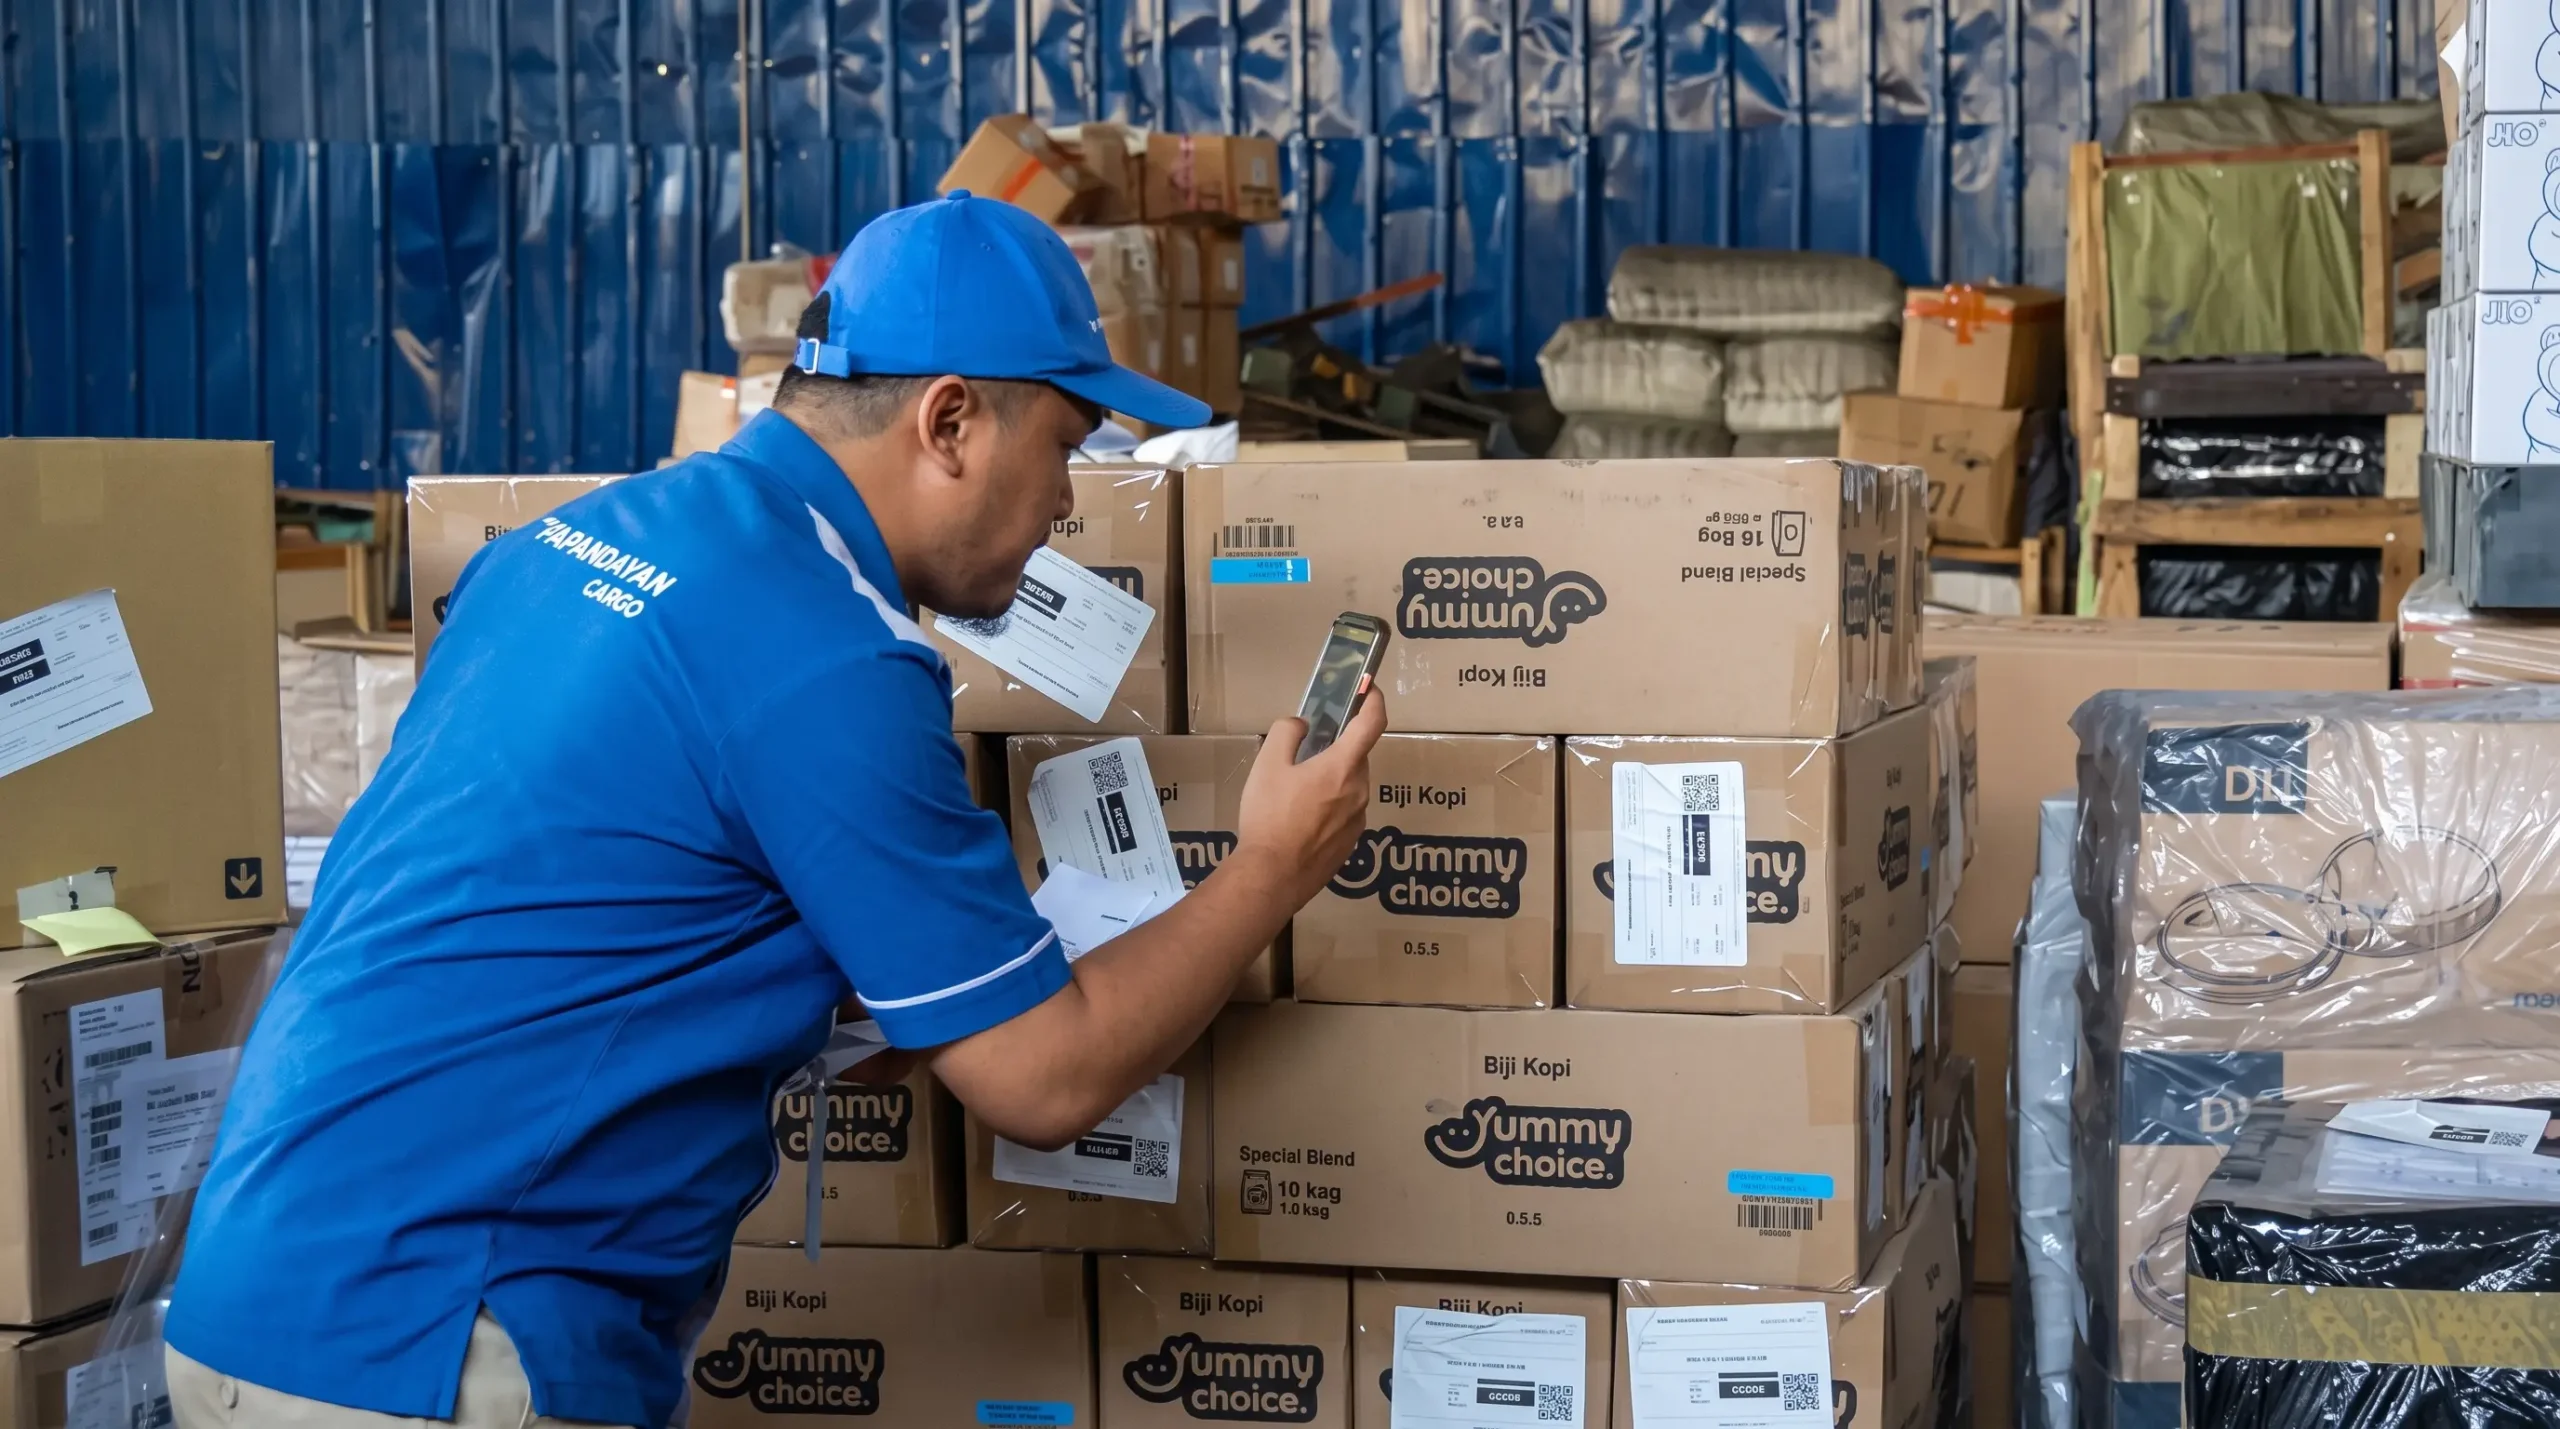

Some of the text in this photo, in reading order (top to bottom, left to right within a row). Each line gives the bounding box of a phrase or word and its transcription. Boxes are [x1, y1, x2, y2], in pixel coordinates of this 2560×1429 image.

[1698, 527, 1764, 546] 16 Bog
[1412, 567, 1534, 598] choice.
[1740, 563, 1806, 582] Special
[582, 579, 644, 618] CARGO
[1406, 582, 1597, 638] Yummy
[1458, 667, 1505, 687] Kopi
[1379, 785, 1466, 809] Biji Kopi
[1334, 835, 1517, 888] Yummy
[1390, 876, 1510, 909] choice.
[1404, 942, 1440, 956] 0.5.5
[1484, 1056, 1571, 1081] Biji Kopi
[1434, 1106, 1622, 1158] Yummy
[1240, 1145, 1355, 1167] Special Blend
[1494, 1148, 1614, 1181] choice.
[1278, 1181, 1341, 1204] 10 kag
[1280, 1202, 1329, 1220] 1.0 ksg
[1506, 1211, 1542, 1226] 0.5.5
[745, 1290, 826, 1313] Biji Kopi
[1180, 1292, 1263, 1317] Biji Kopi
[701, 1338, 876, 1388] Yummy
[1133, 1342, 1314, 1393] Yummy
[1192, 1381, 1308, 1414] choice.
